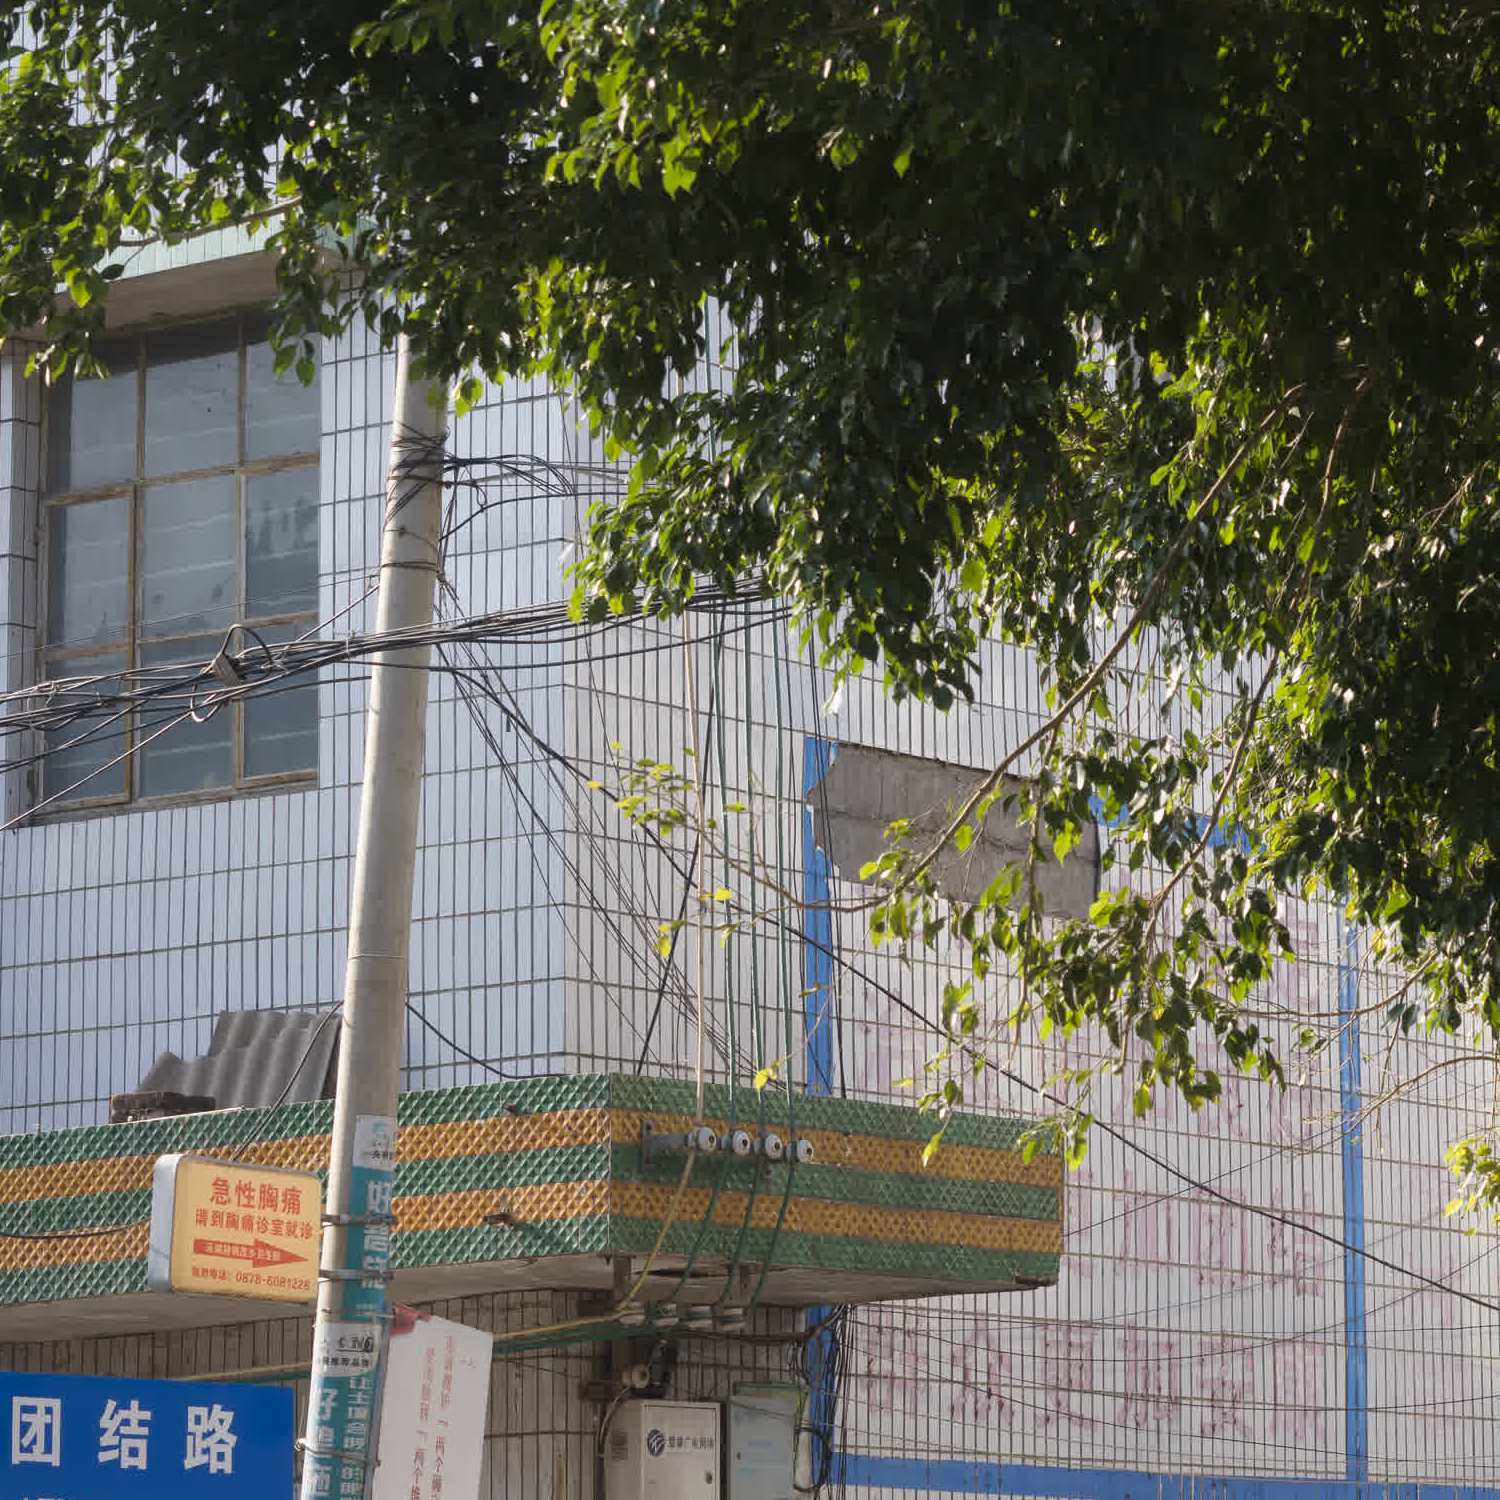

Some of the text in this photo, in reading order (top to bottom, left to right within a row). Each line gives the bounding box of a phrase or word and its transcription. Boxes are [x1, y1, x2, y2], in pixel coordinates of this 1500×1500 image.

[210, 1175, 302, 1216] 急性胸痛
[196, 1208, 313, 1240] 请到胸痛诊室就诊
[11, 1396, 238, 1475] 团结路
